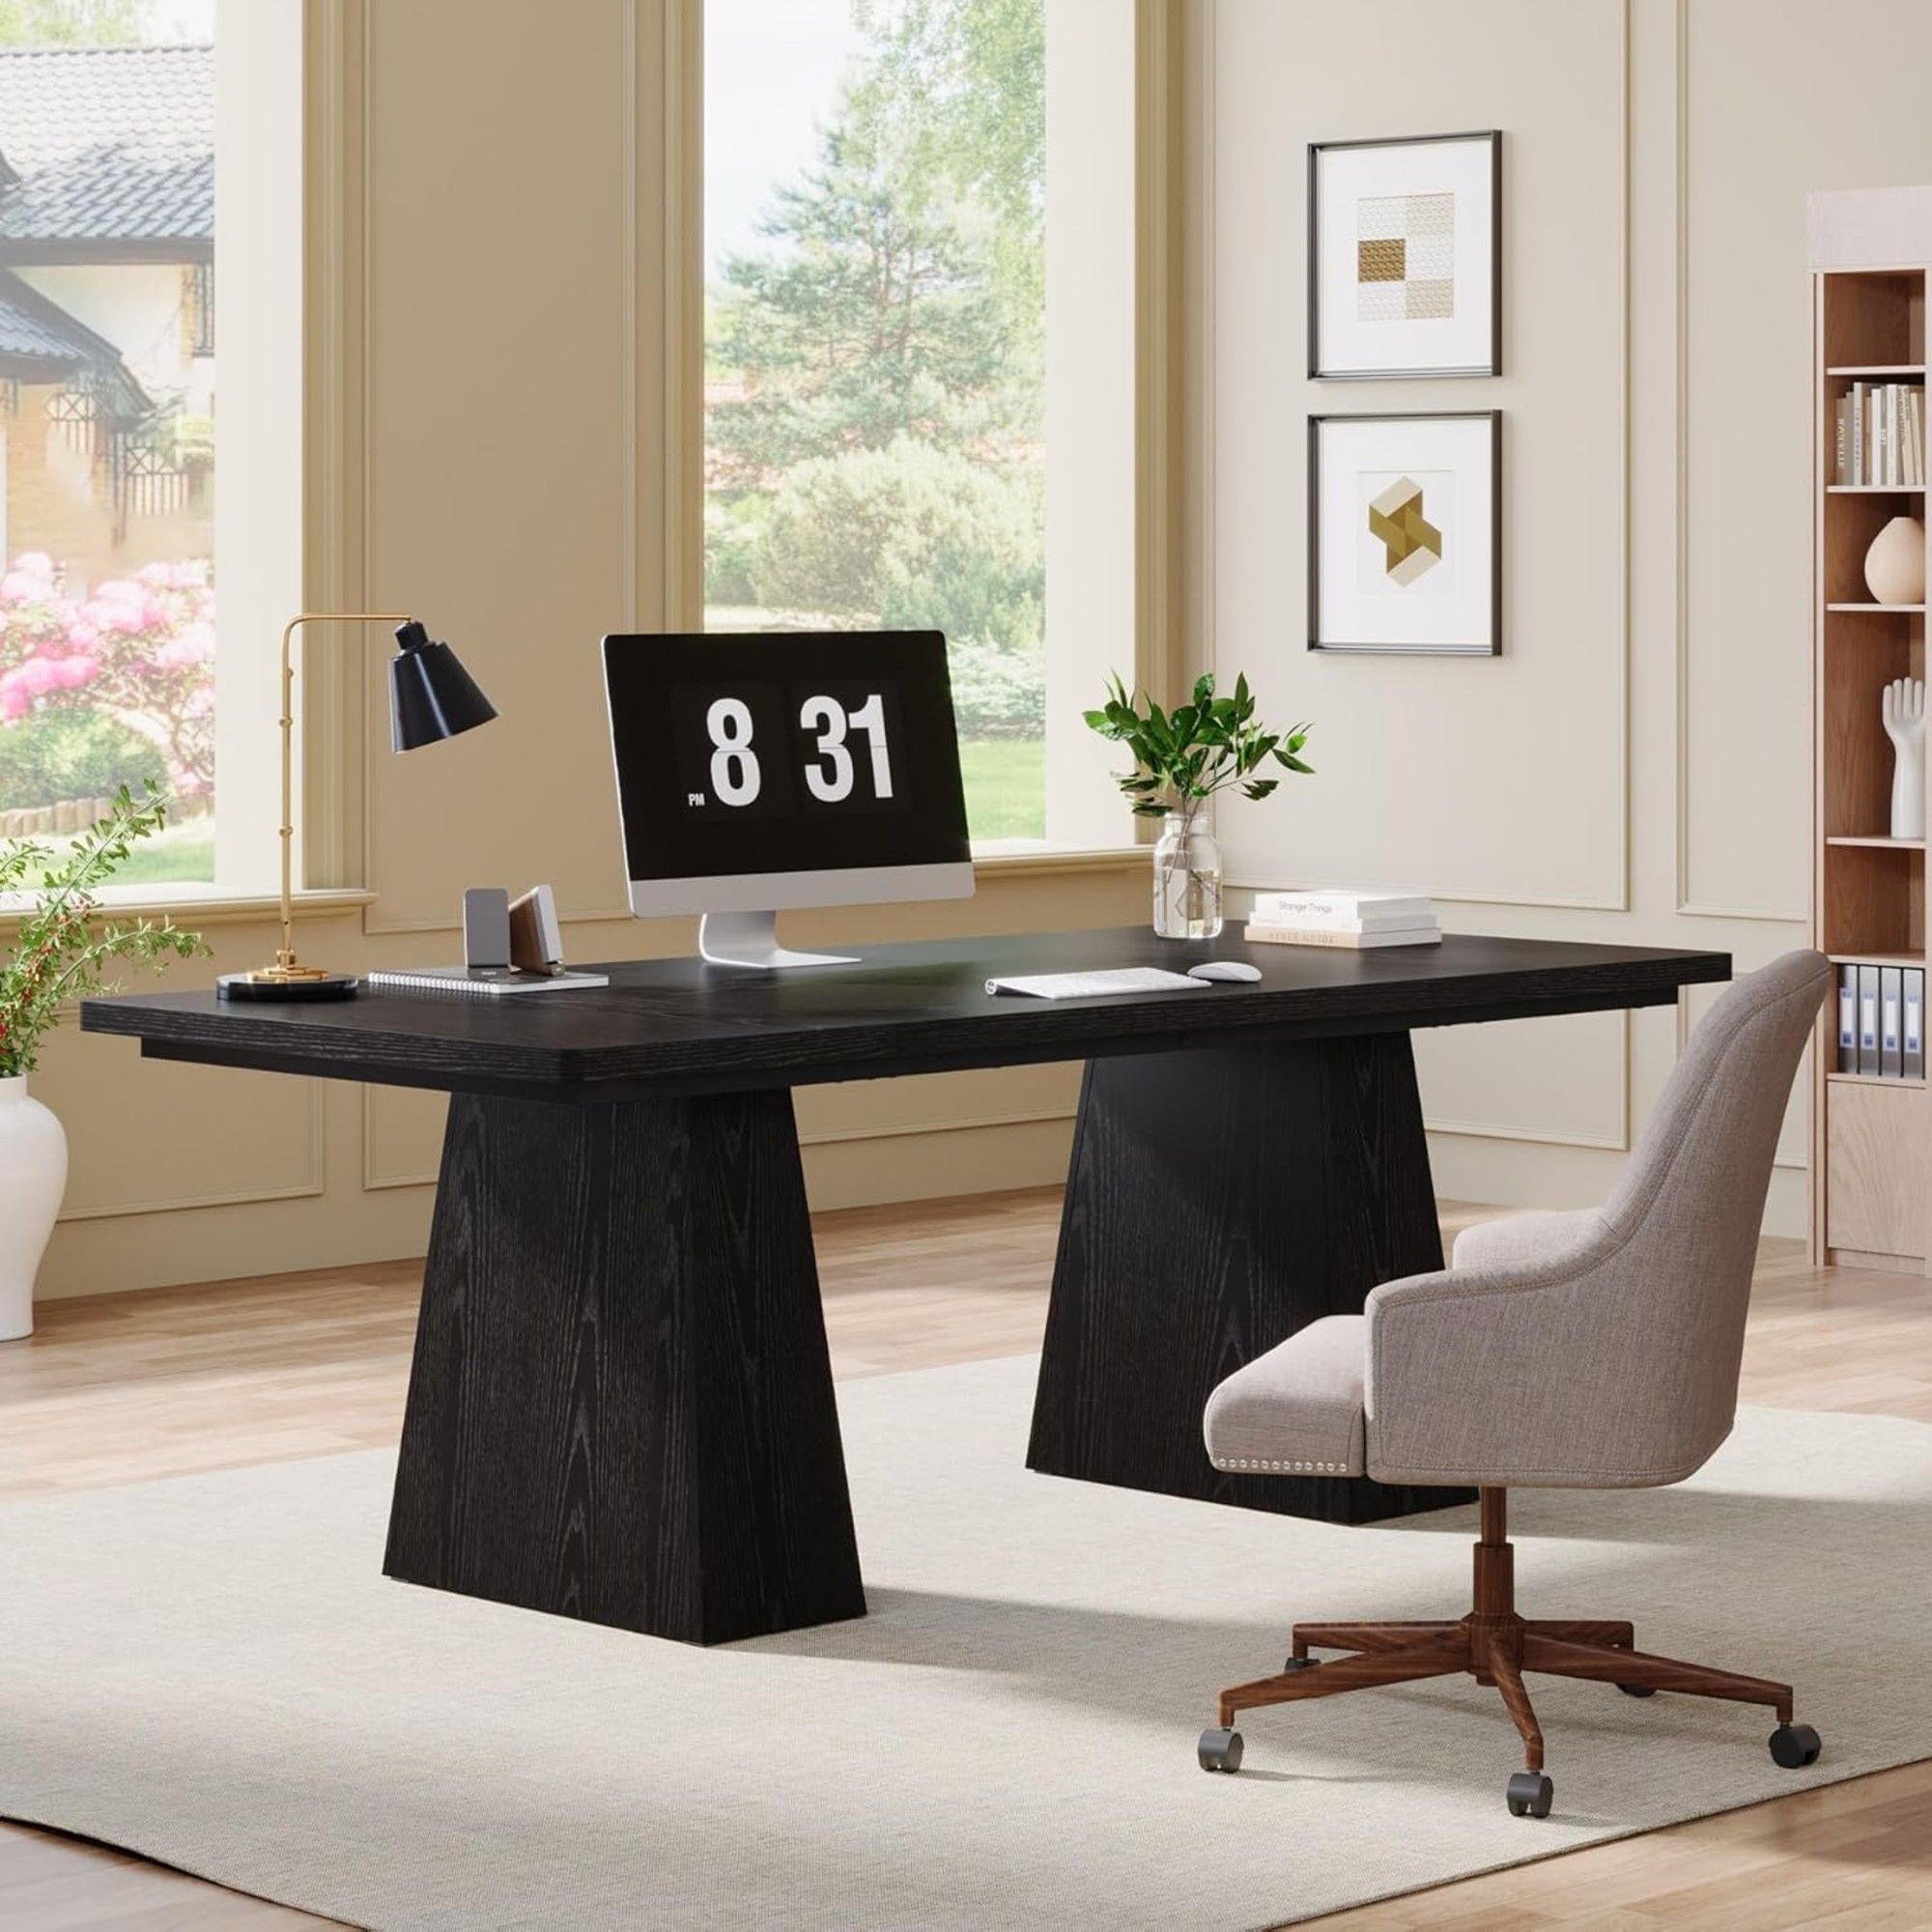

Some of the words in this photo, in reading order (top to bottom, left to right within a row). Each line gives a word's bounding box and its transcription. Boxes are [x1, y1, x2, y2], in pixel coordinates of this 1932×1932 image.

[707, 697, 761, 807] 8
[800, 694, 894, 803] 31
[688, 793, 705, 807] PM
